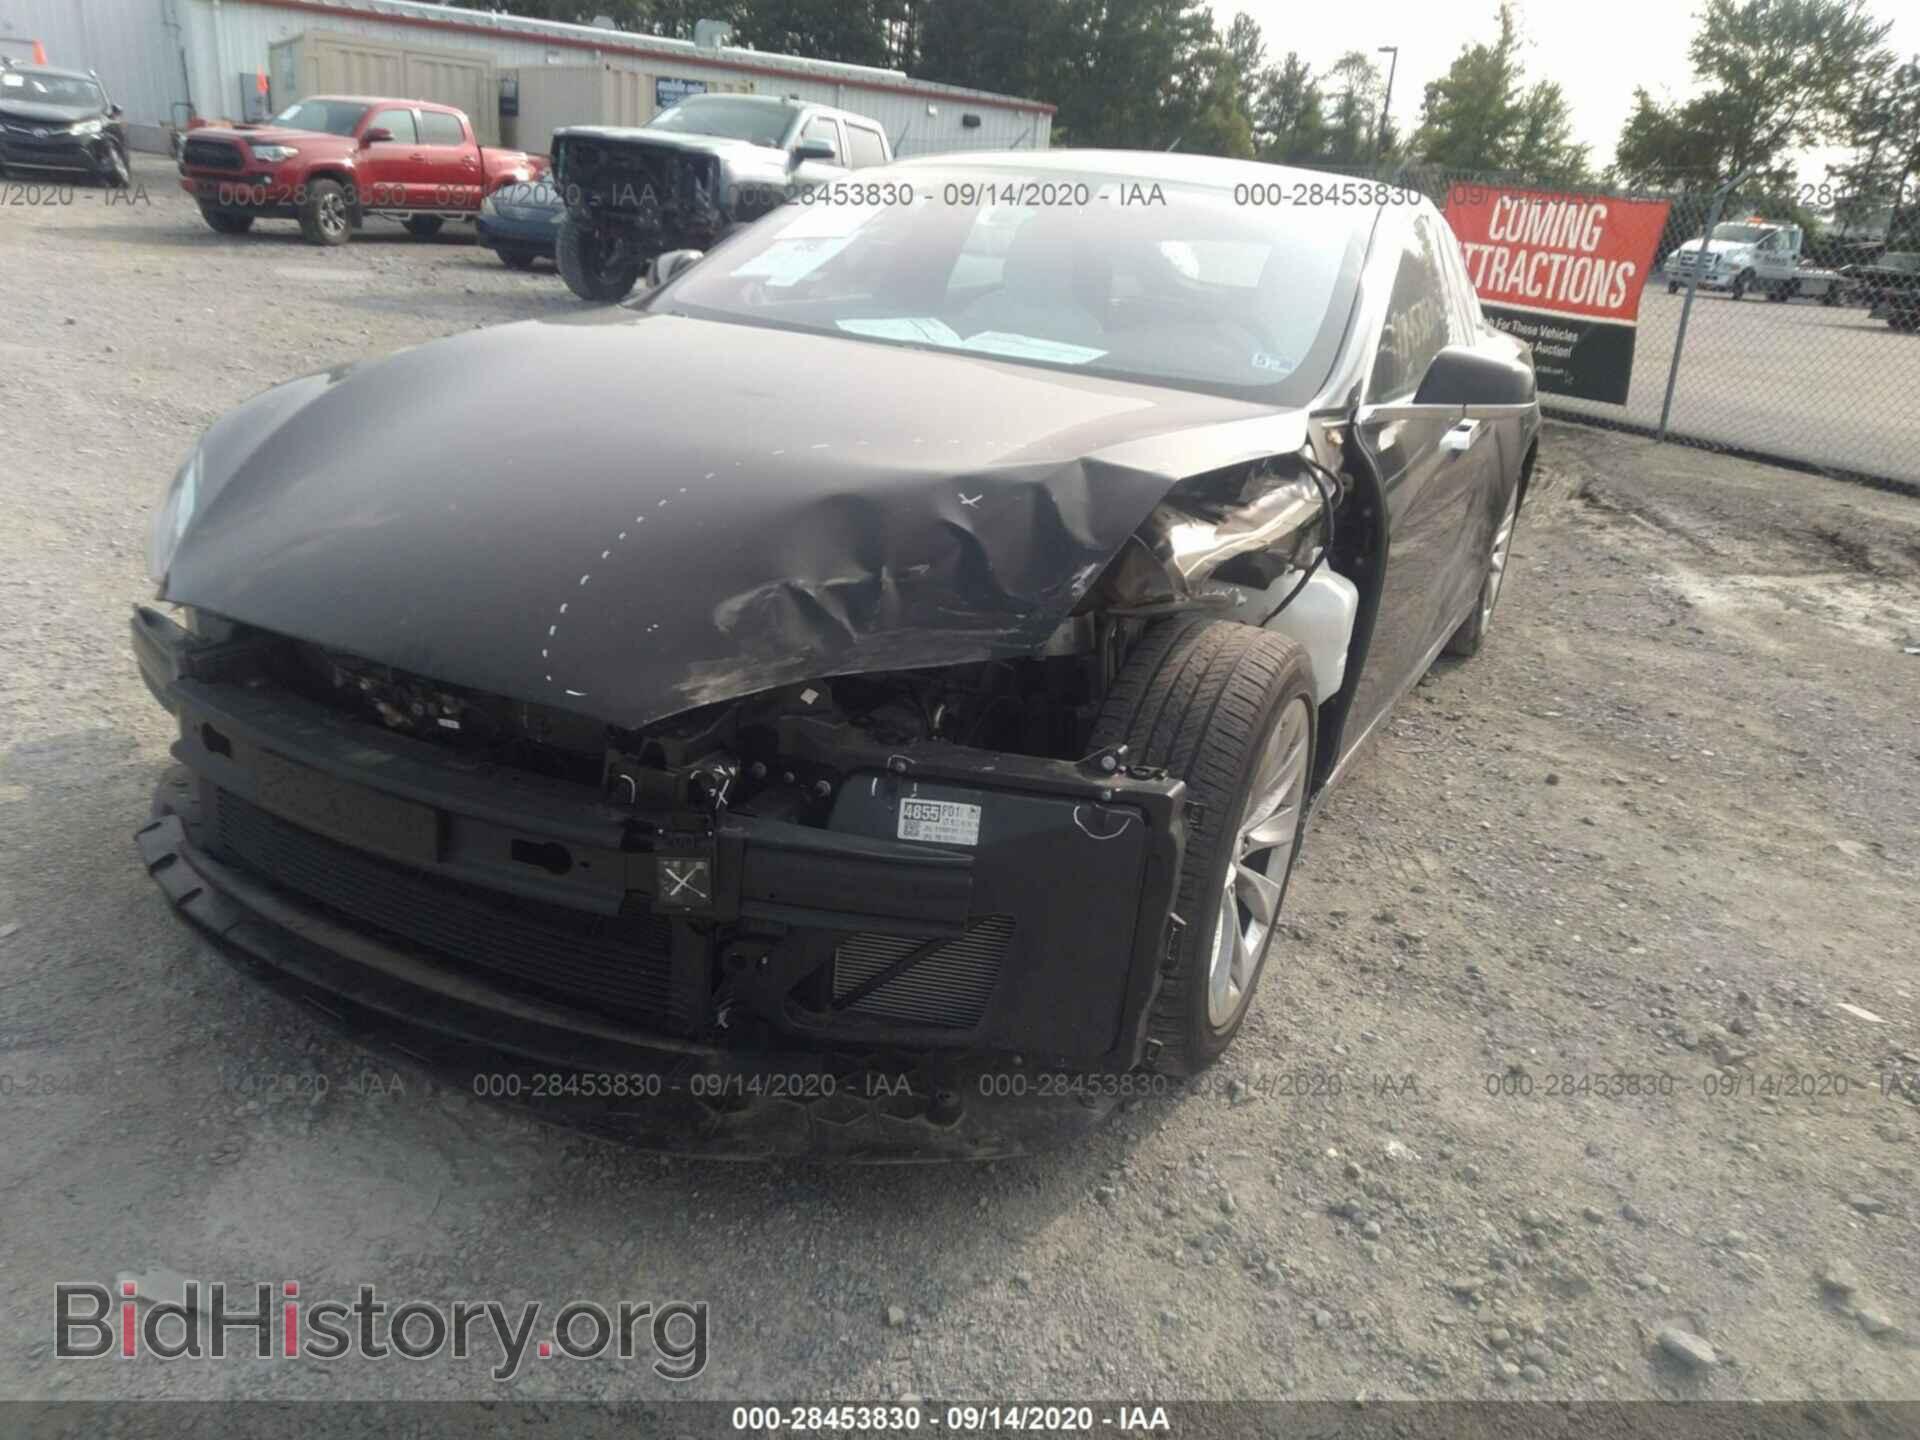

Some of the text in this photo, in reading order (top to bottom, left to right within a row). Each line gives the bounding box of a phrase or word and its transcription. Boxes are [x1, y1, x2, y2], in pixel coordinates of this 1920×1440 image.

[1488, 195, 1608, 252] COMING
[1496, 318, 1511, 331] For
[1540, 325, 1578, 342] Vehicles
